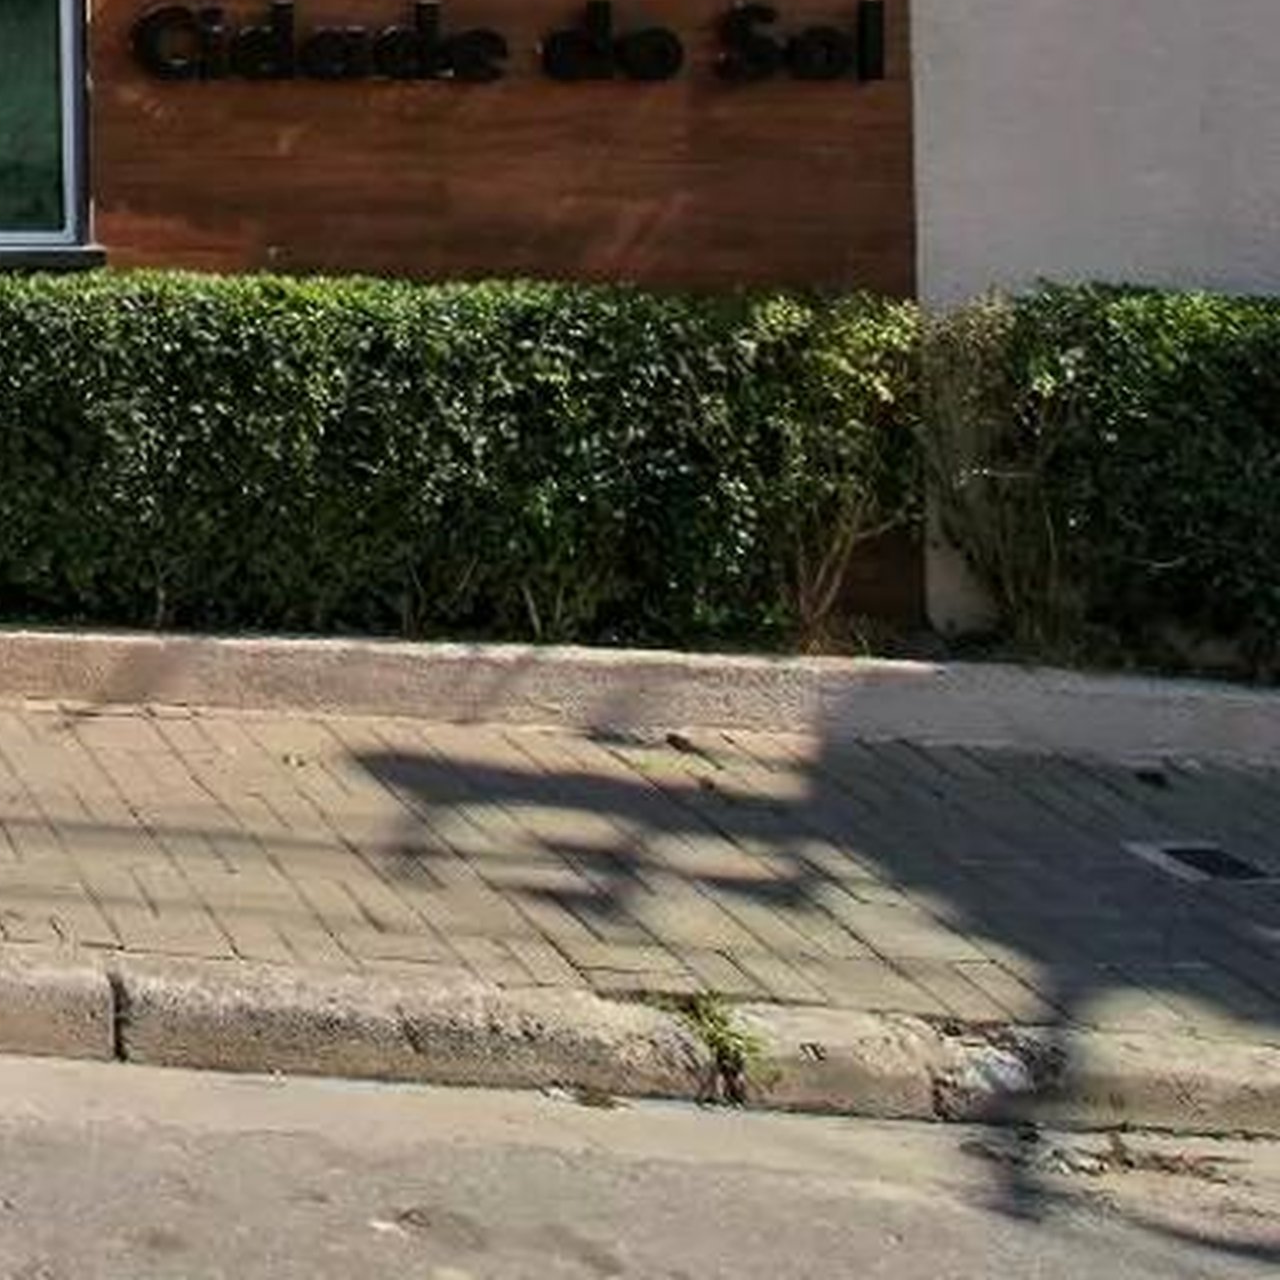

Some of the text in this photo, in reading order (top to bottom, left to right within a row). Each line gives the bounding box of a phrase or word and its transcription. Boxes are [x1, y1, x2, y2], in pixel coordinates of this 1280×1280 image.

[131, 0, 884, 81] Cidade do Sol
